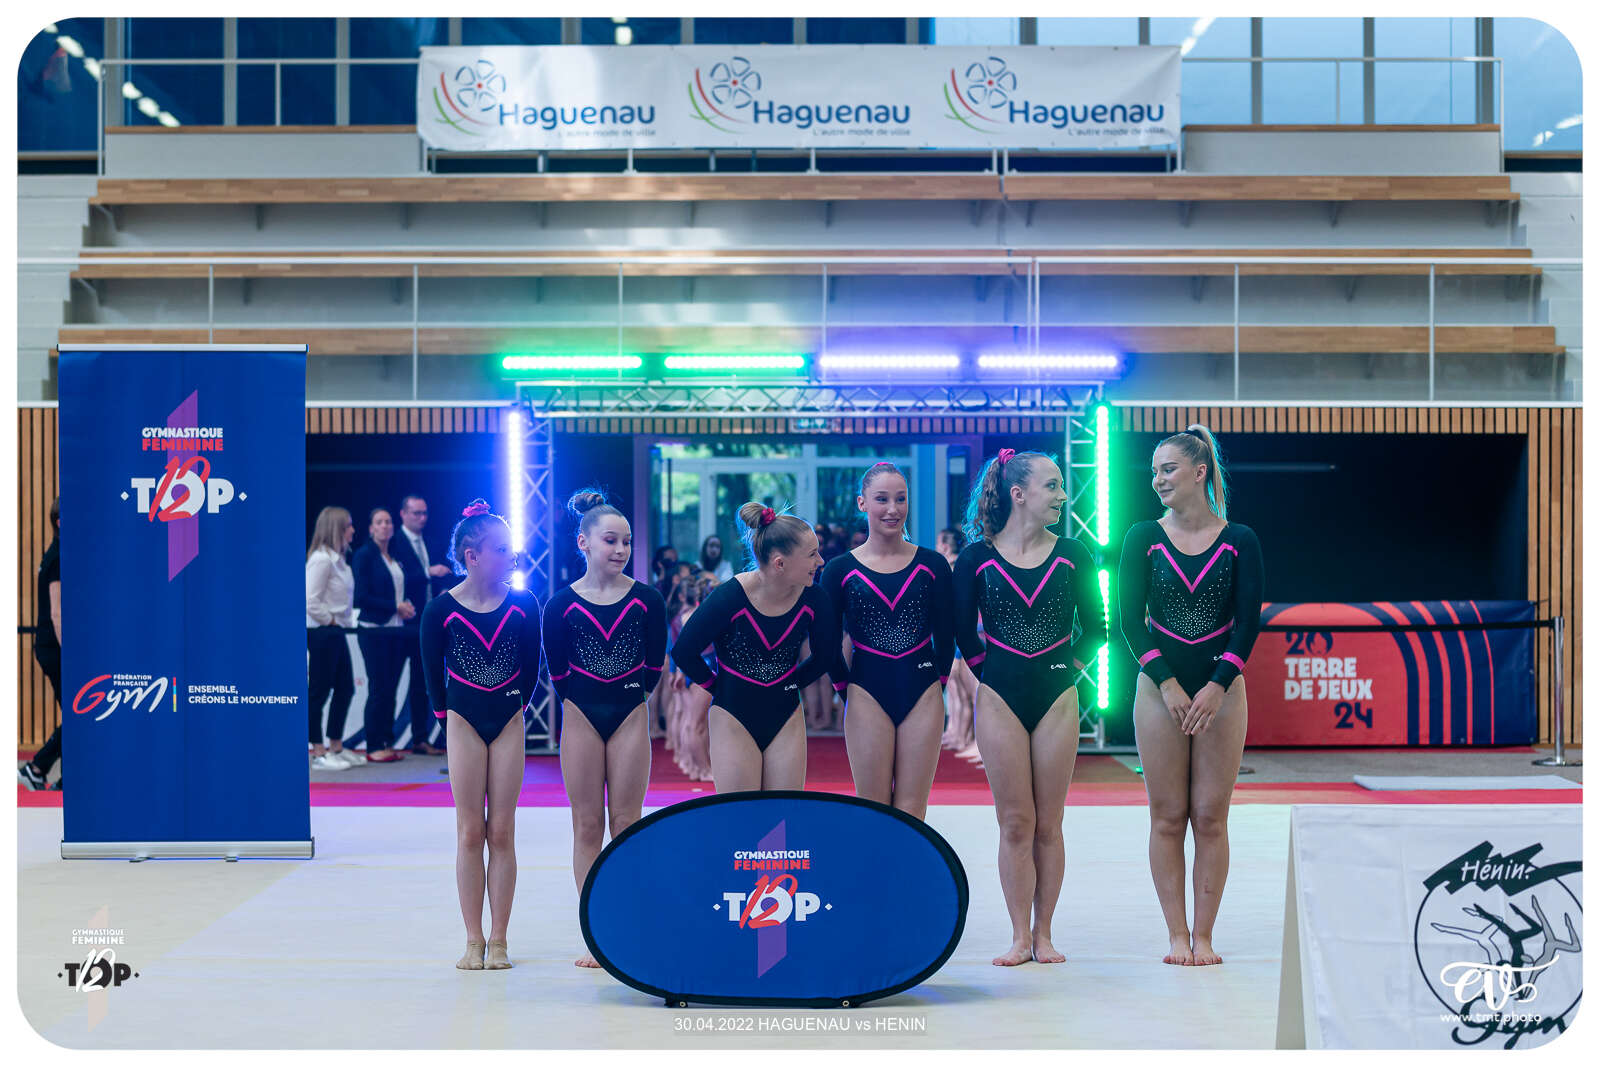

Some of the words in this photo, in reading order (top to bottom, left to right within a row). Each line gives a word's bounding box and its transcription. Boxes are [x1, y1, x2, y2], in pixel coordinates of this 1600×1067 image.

[499, 103, 656, 130] Haguenau
[753, 100, 910, 129] Haguenau
[1009, 100, 1164, 128] Haguenau
[142, 427, 223, 438] GYMNASTIQUE
[1284, 657, 1357, 678] TERRE
[188, 685, 239, 695] ENSEMBLE,
[228, 696, 239, 704] LE
[241, 696, 298, 704] MOUVEMENT
[1284, 679, 1314, 700] DE
[1317, 679, 1373, 700] JEUX
[1334, 702, 1373, 728] 24
[733, 850, 810, 860] GYMNASTIQUE
